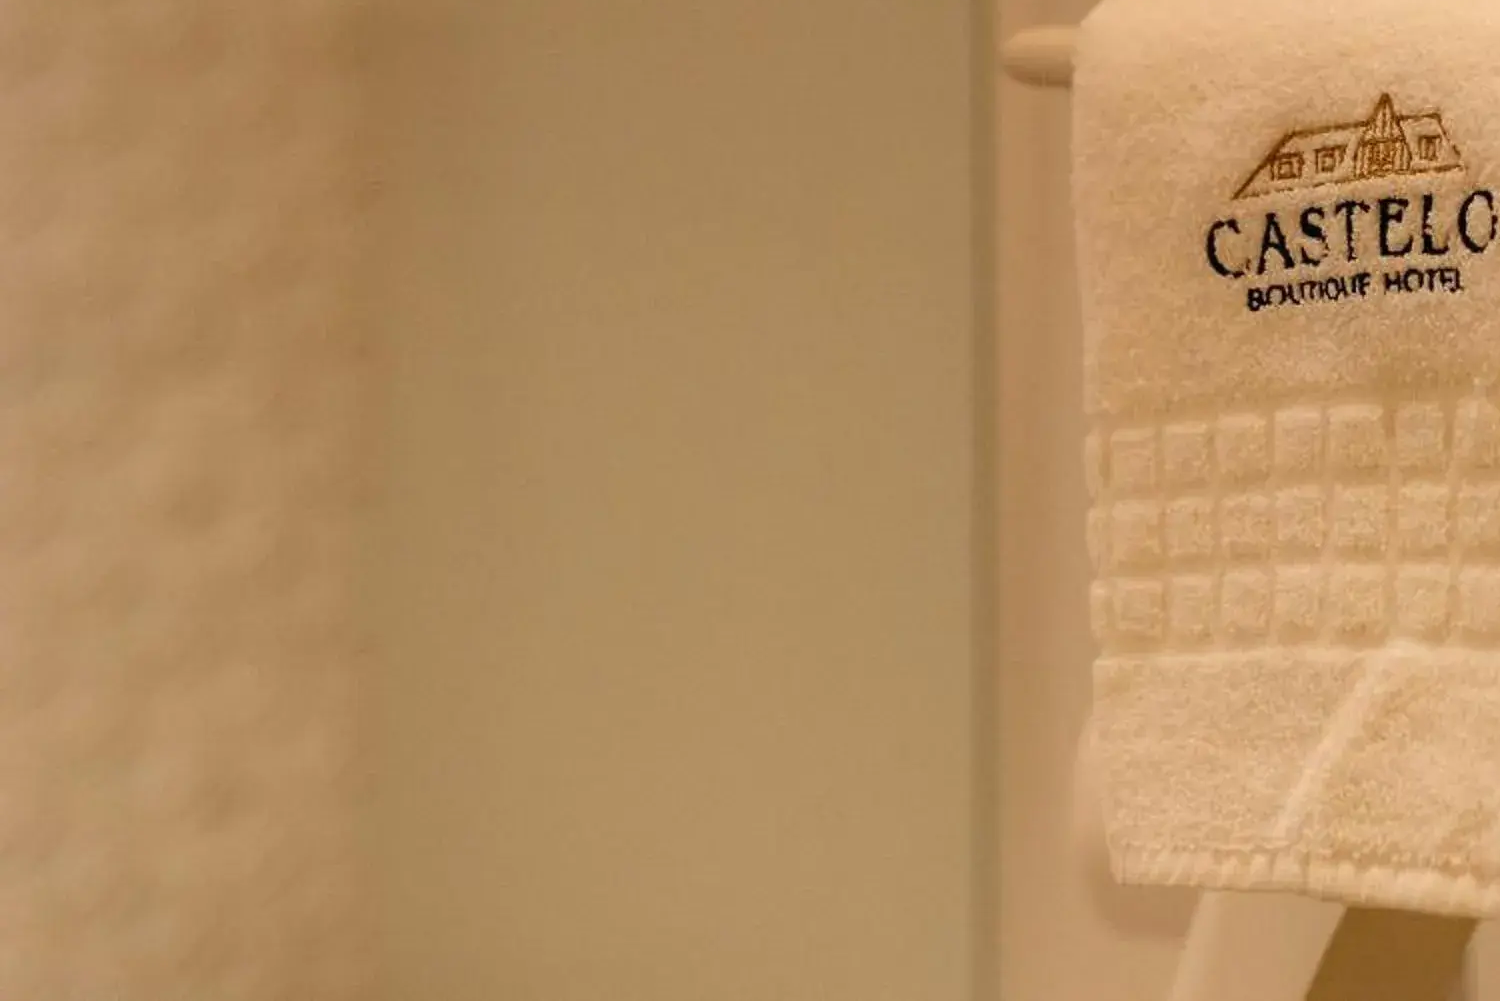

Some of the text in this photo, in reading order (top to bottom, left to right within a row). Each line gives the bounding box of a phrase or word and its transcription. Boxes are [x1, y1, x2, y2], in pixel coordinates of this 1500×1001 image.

[1206, 189, 1498, 278] CASTELO
[1246, 267, 1465, 311] BOUTIQUE HOTEL
